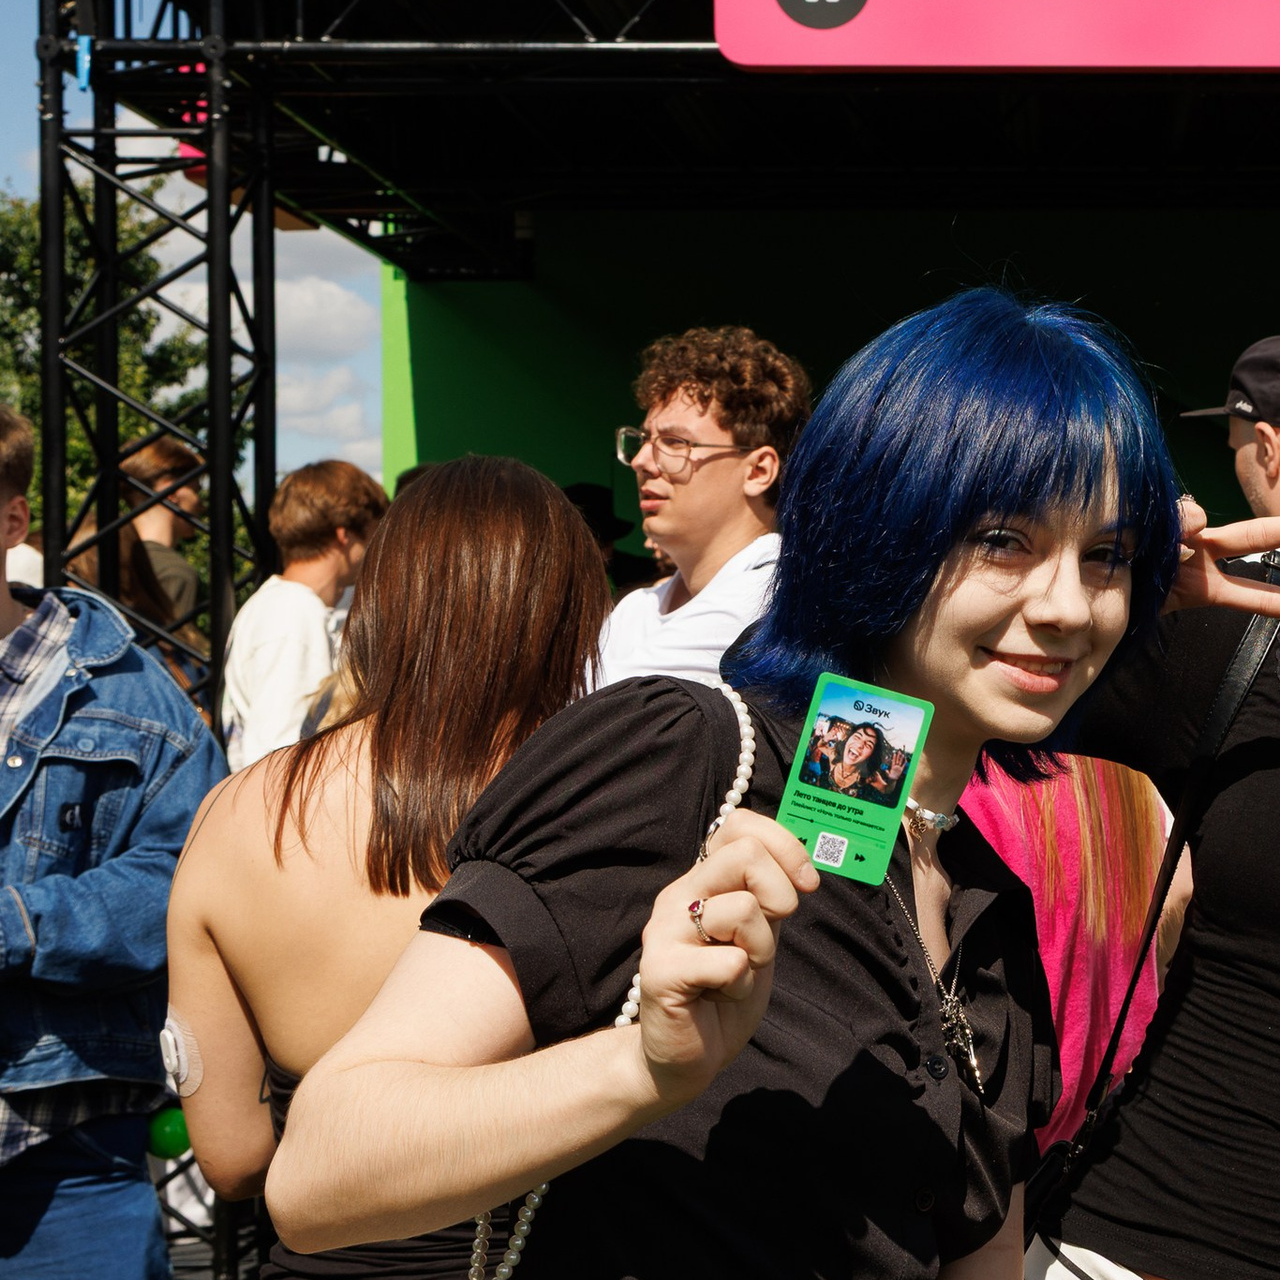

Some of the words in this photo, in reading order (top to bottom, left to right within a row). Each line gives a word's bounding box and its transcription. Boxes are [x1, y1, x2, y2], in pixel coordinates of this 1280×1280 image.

[864, 703, 891, 719] Звук
[791, 800, 817, 812] Плейлист
[793, 789, 811, 801] Лето
[812, 796, 837, 808] танцев
[837, 802, 846, 811] до
[846, 806, 864, 816] утра
